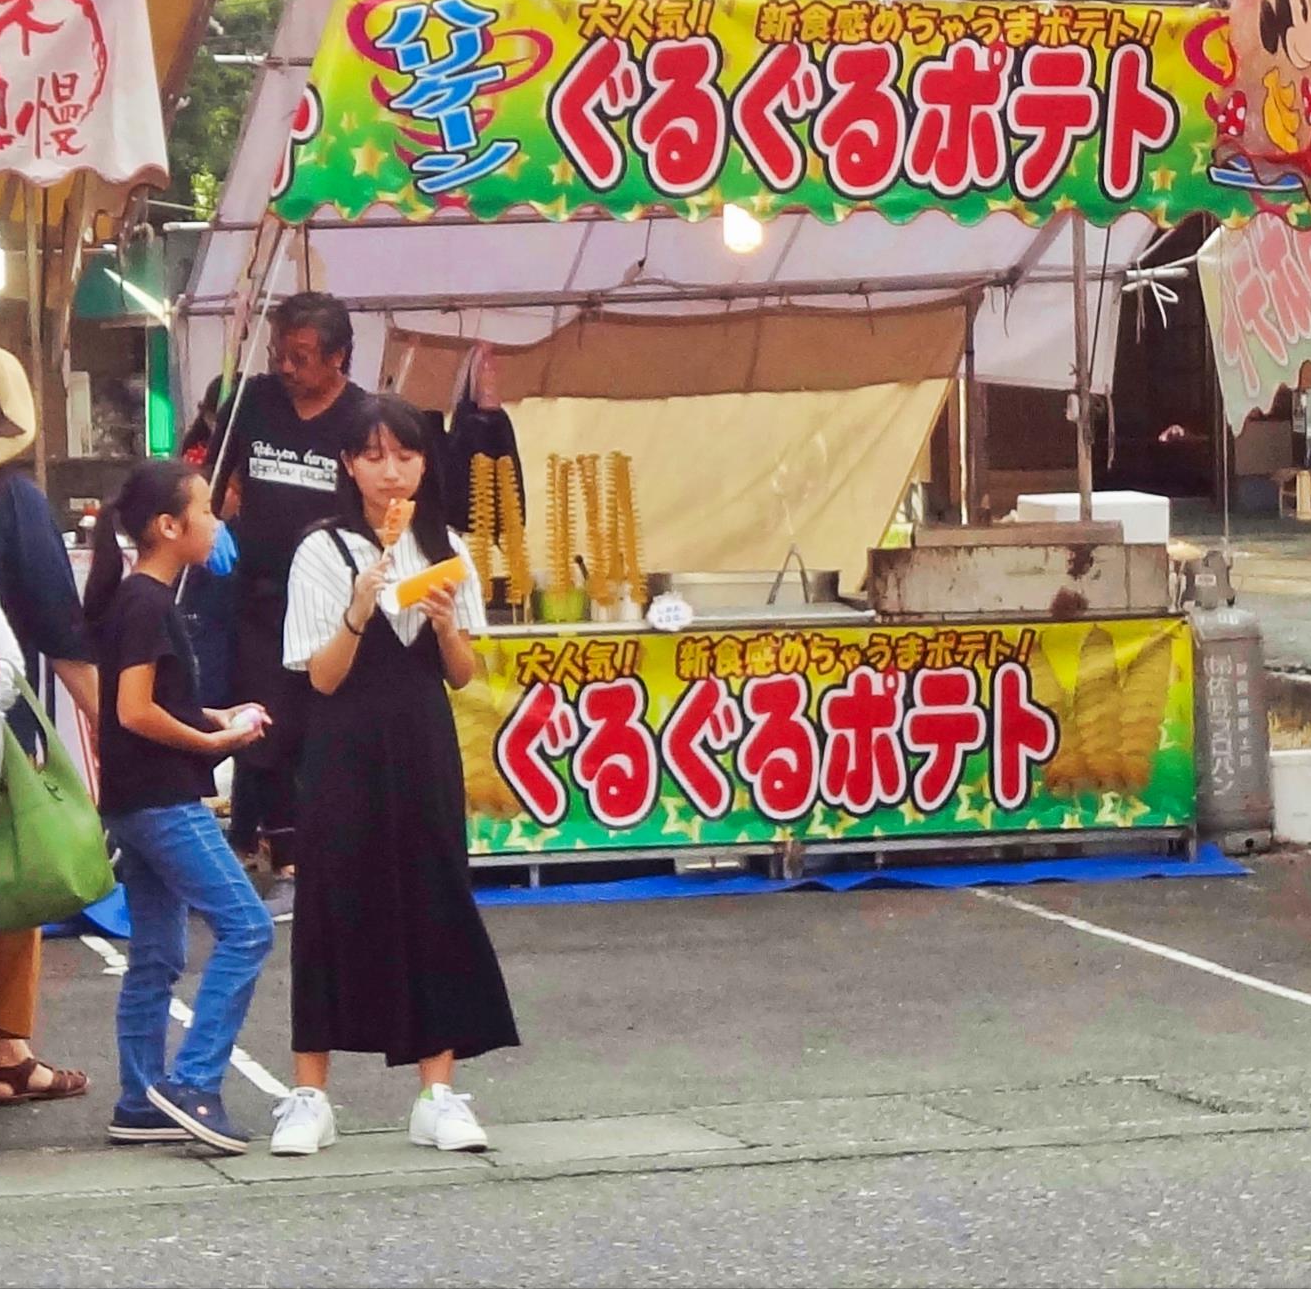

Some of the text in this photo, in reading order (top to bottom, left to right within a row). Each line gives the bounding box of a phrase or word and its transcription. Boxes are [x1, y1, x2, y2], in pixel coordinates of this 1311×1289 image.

[547, 34, 1179, 200] ぐるぐるポテト
[518, 629, 1037, 685] 大人気! 新食感めちゃうまポテト!
[496, 661, 1060, 827] ぐるぐるポテト
